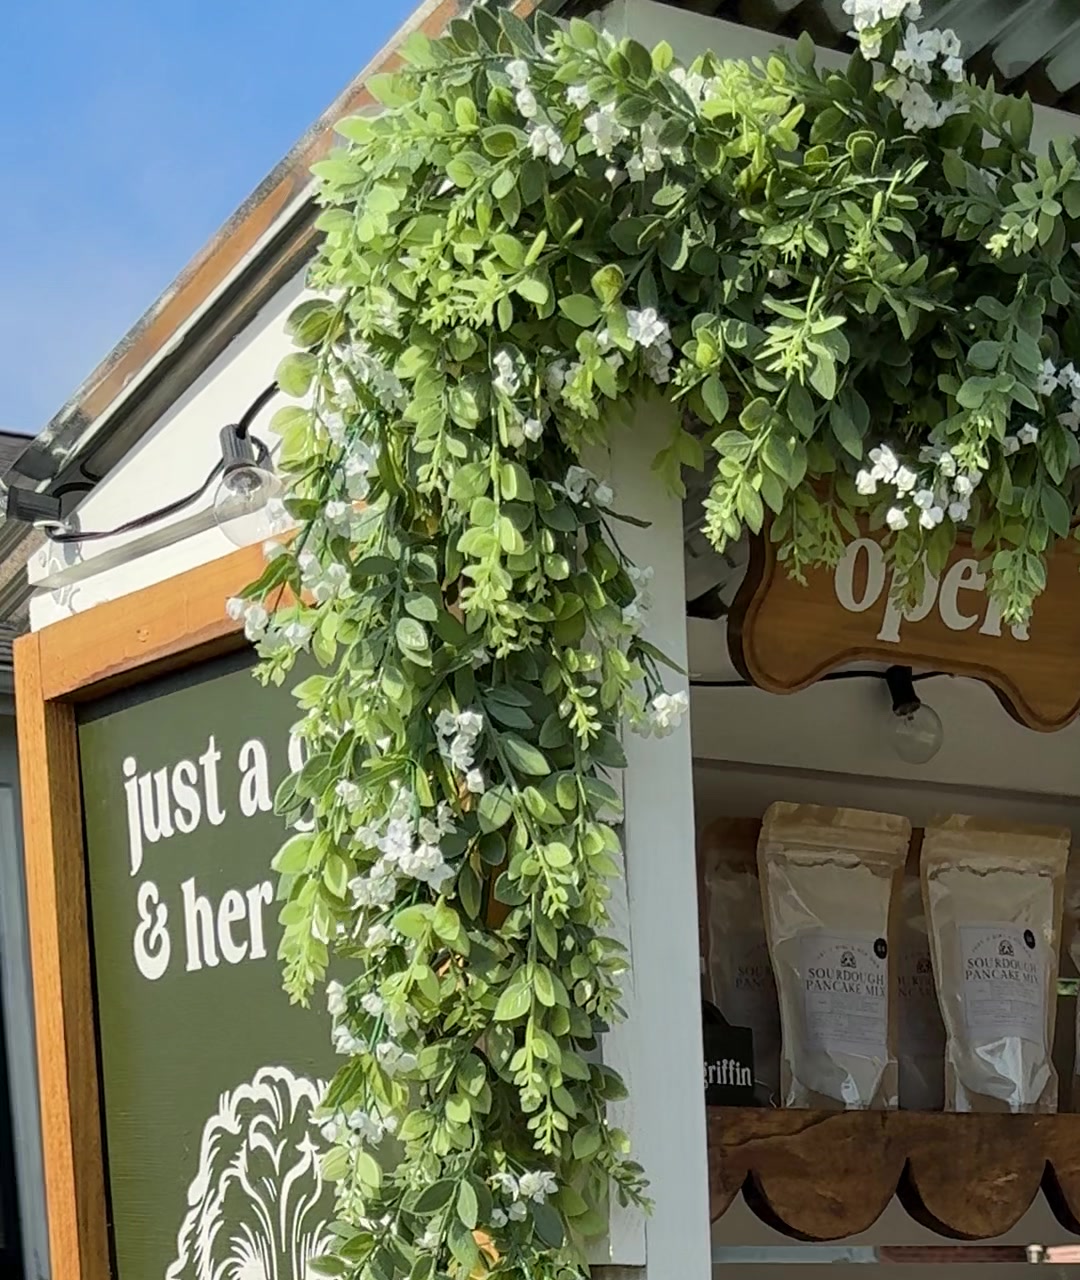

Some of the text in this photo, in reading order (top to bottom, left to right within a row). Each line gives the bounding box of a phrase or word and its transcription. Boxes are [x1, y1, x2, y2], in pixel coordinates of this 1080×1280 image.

[122, 734, 226, 877] just
[238, 738, 273, 817] a
[133, 875, 274, 981] & her
[807, 967, 884, 986] SOURDOUGH
[965, 968, 1021, 981] PANCAKE
[805, 979, 861, 995] PANCAKE
[865, 983, 886, 998] MIX
